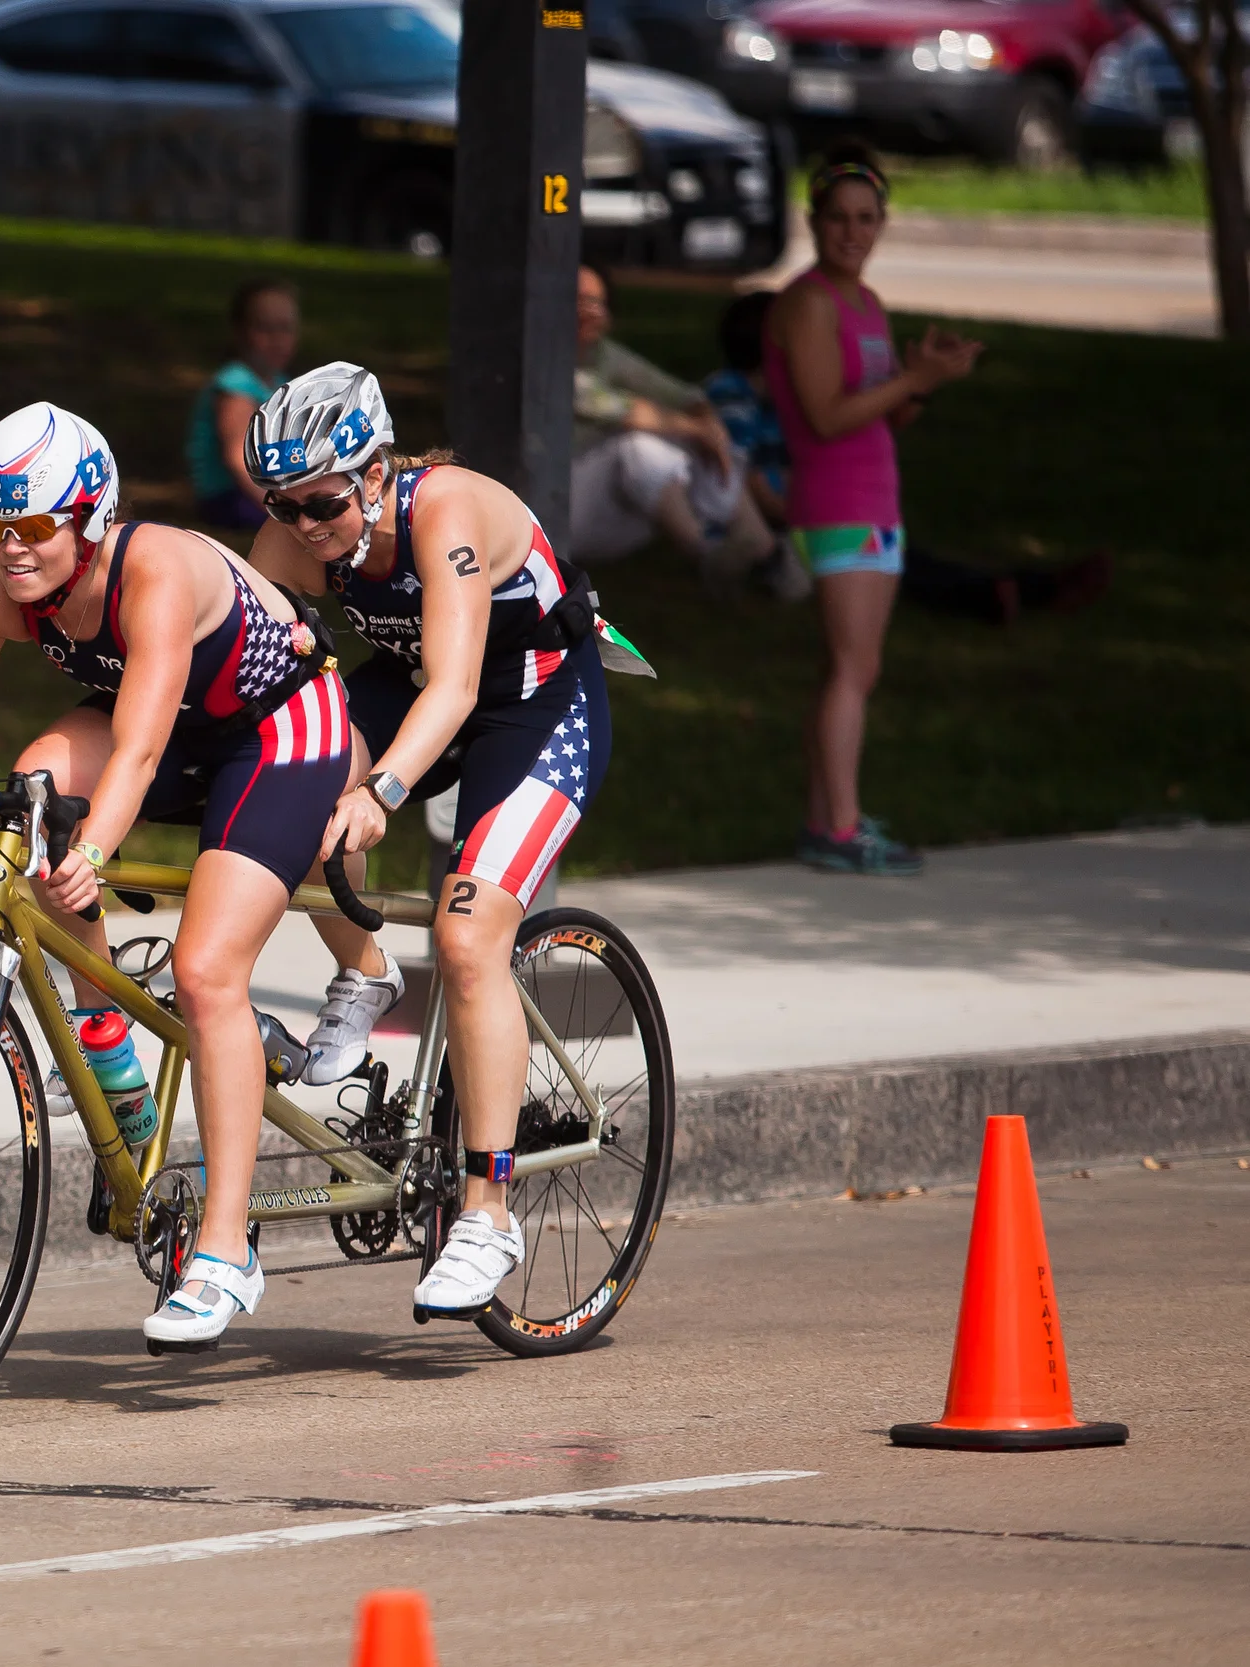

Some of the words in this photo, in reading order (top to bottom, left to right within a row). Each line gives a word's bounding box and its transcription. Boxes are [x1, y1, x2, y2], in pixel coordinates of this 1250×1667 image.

[543, 174, 569, 214] 12
[340, 425, 359, 450] 2
[265, 448, 281, 472] 2
[86, 461, 102, 491] 2
[448, 545, 481, 578] 2
[369, 615, 413, 628] Guiding
[370, 625, 390, 635] For
[392, 626, 416, 636] The
[96, 655, 125, 671] TYR
[446, 880, 478, 916] 2
[553, 930, 607, 956] VIGOR
[283, 1187, 331, 1207] CYCLES
